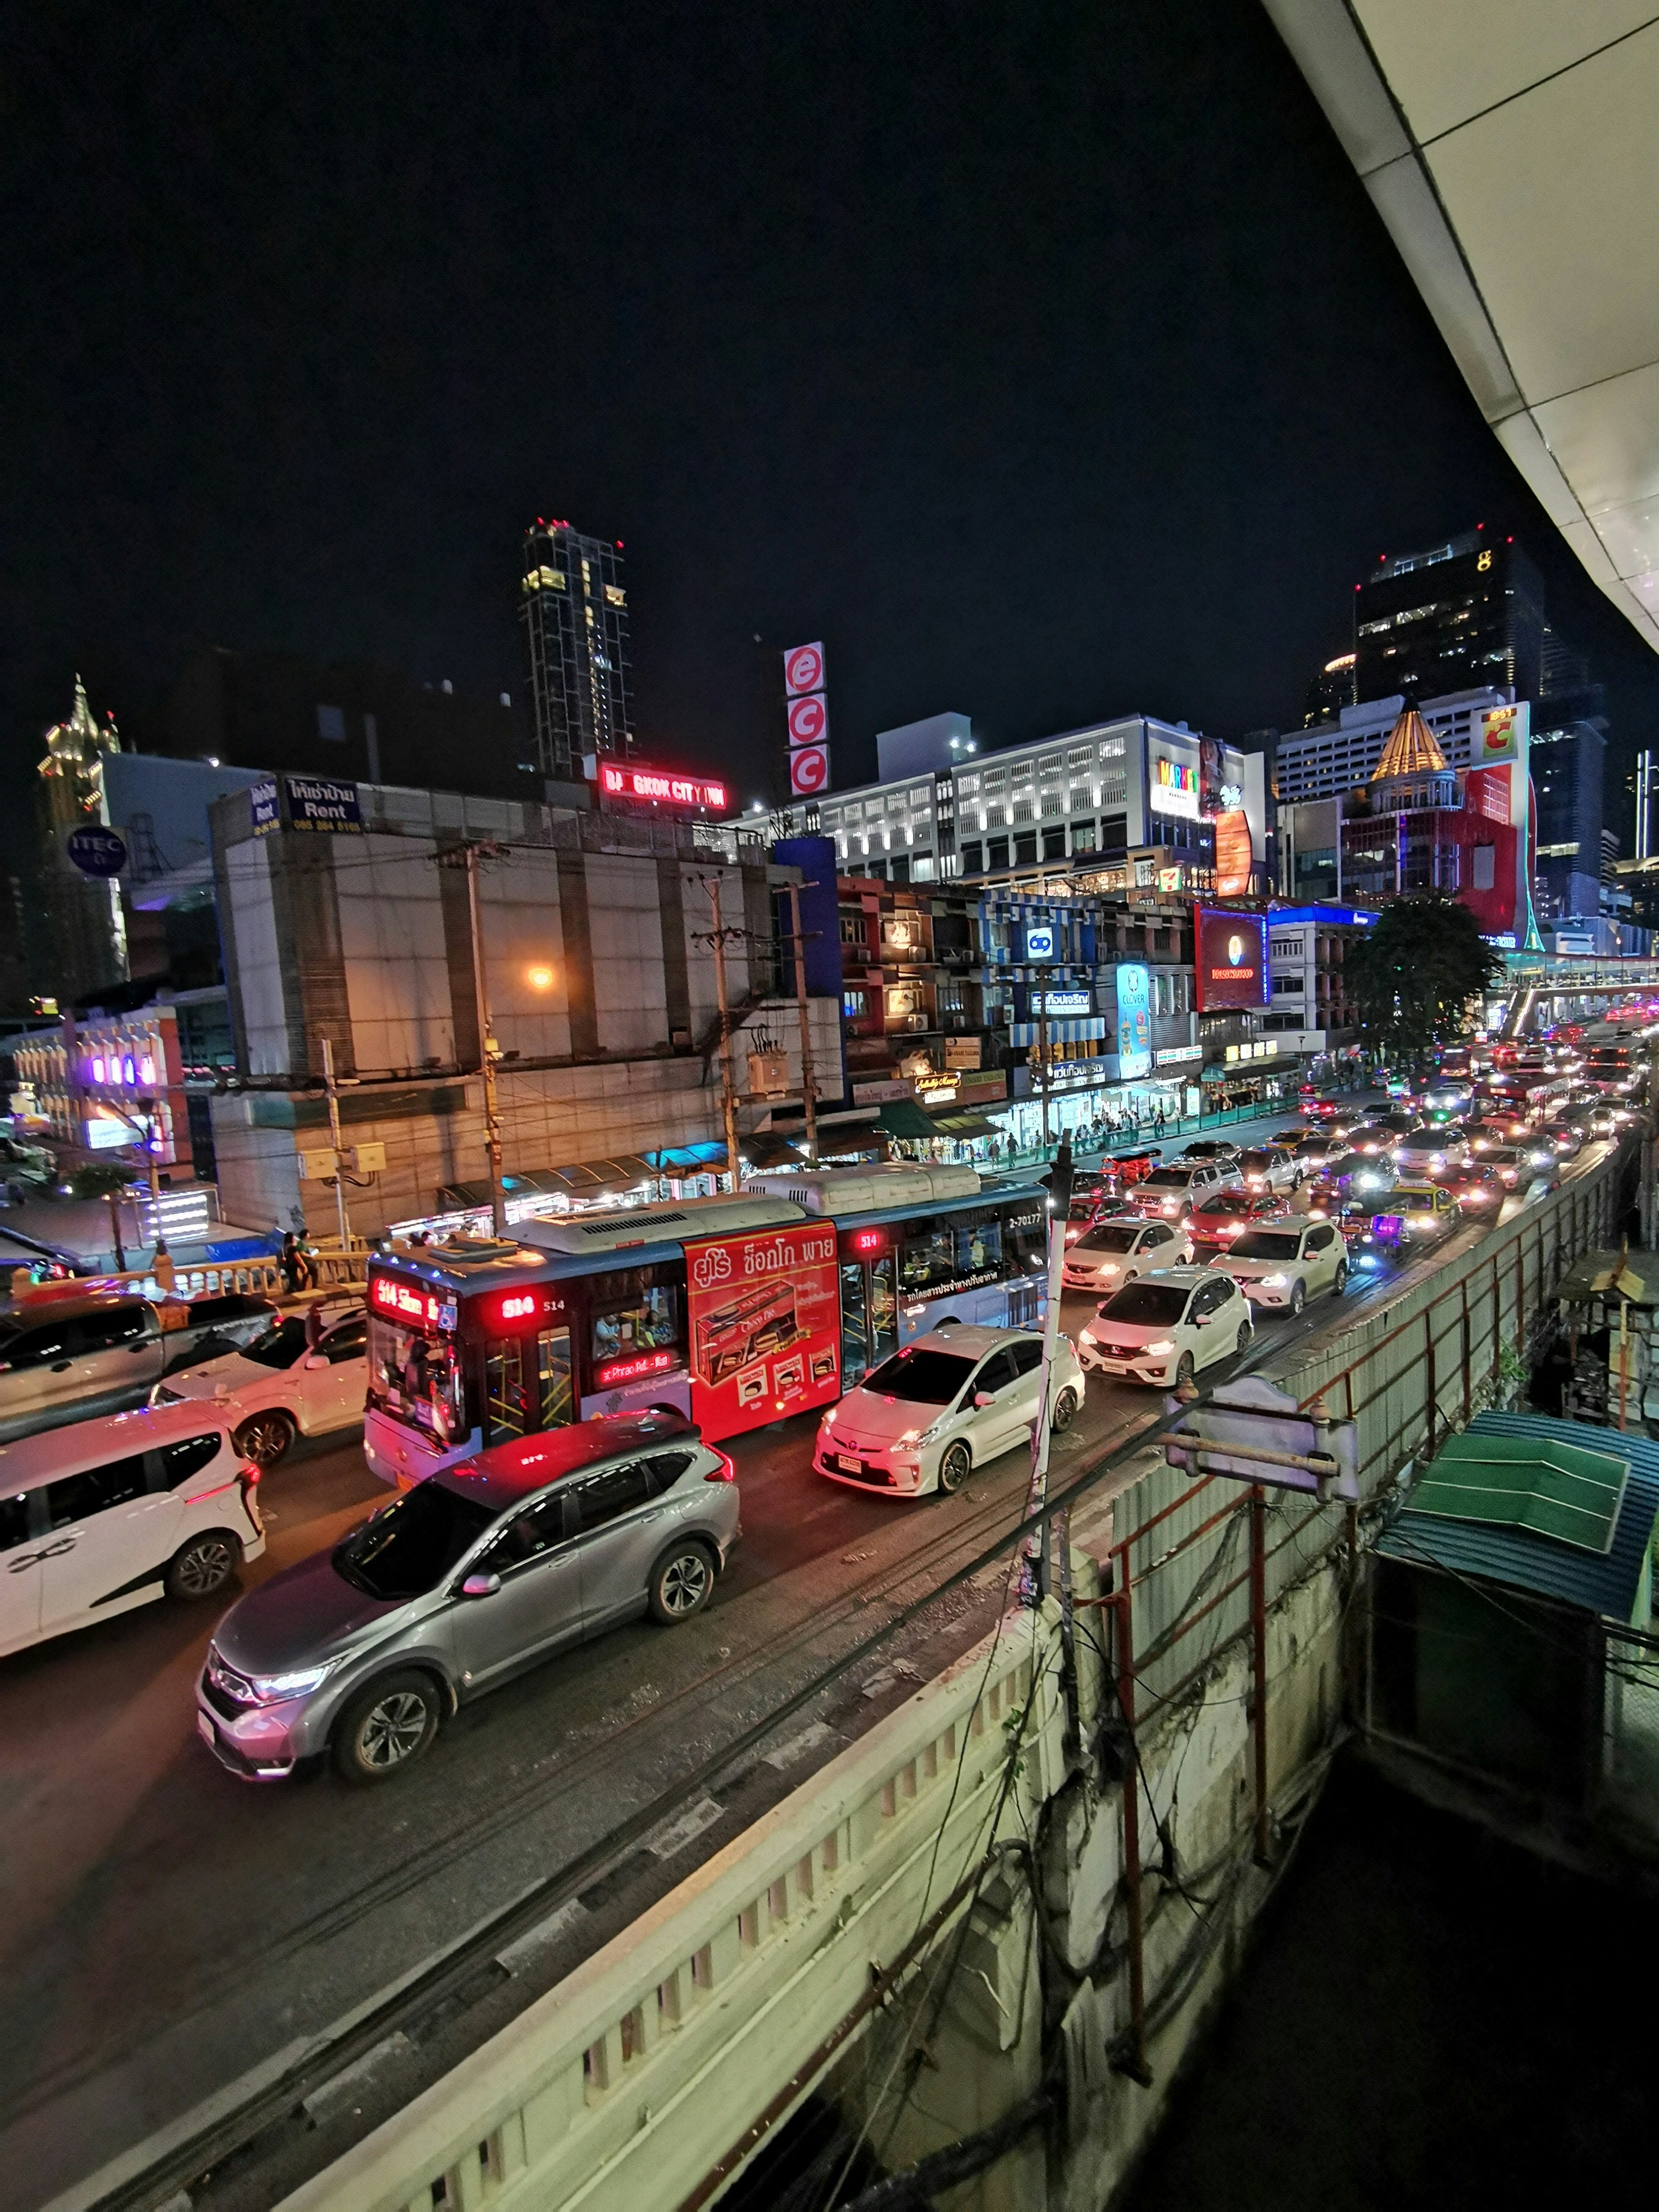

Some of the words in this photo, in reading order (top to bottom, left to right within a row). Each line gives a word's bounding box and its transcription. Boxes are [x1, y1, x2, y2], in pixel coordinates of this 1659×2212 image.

[1160, 760, 1198, 793] MARKET
[672, 780, 700, 803] CITY
[304, 802, 347, 819] Rent
[1008, 1213, 1041, 1229] 2-70177
[802, 1238, 834, 1262] พาย
[860, 1233, 877, 1248] 514
[502, 1295, 535, 1319] 514
[543, 1299, 565, 1312] 514
